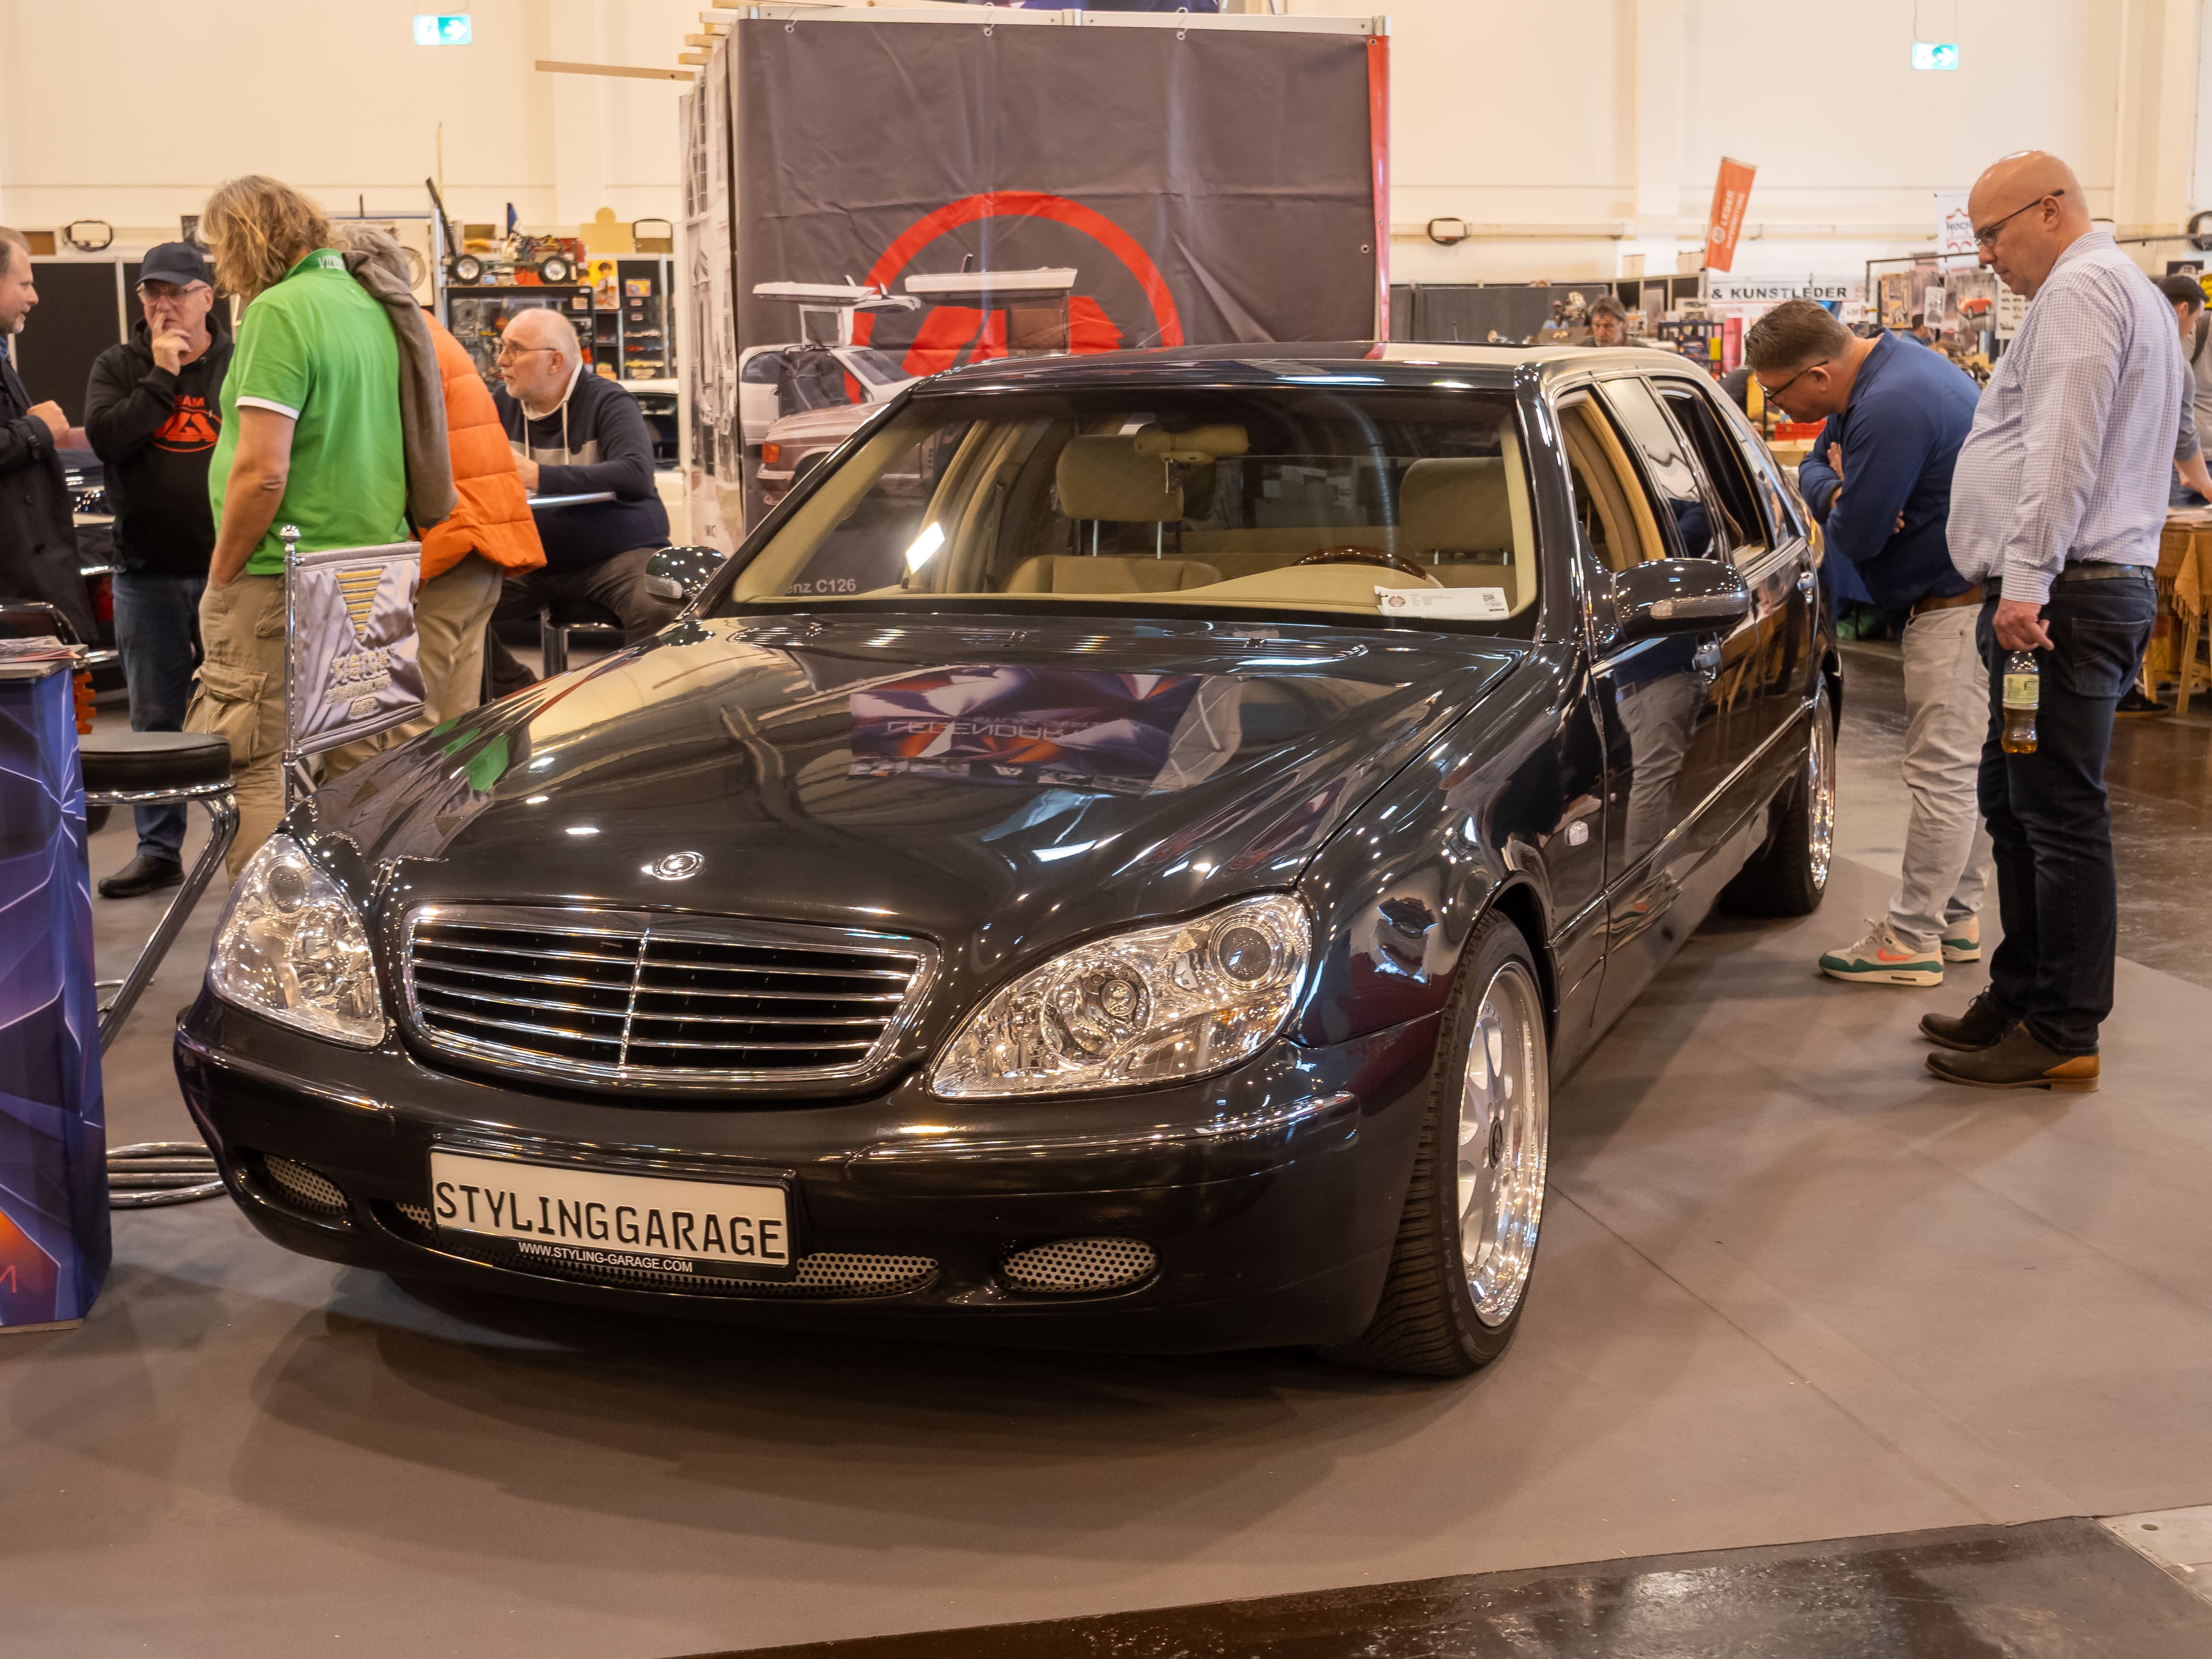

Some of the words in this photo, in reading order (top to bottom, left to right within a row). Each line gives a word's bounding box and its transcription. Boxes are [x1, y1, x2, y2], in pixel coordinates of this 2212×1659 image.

[1719, 190, 1734, 226] LEDER
[1711, 289, 1722, 299] &
[1731, 287, 1847, 298] KUNSTLEDER
[175, 395, 204, 407] EAM
[816, 578, 857, 593] C126
[435, 1181, 787, 1259] STYLINGGARAGE
[518, 1241, 693, 1272] WWW.STYLING-GARAGE.COM
